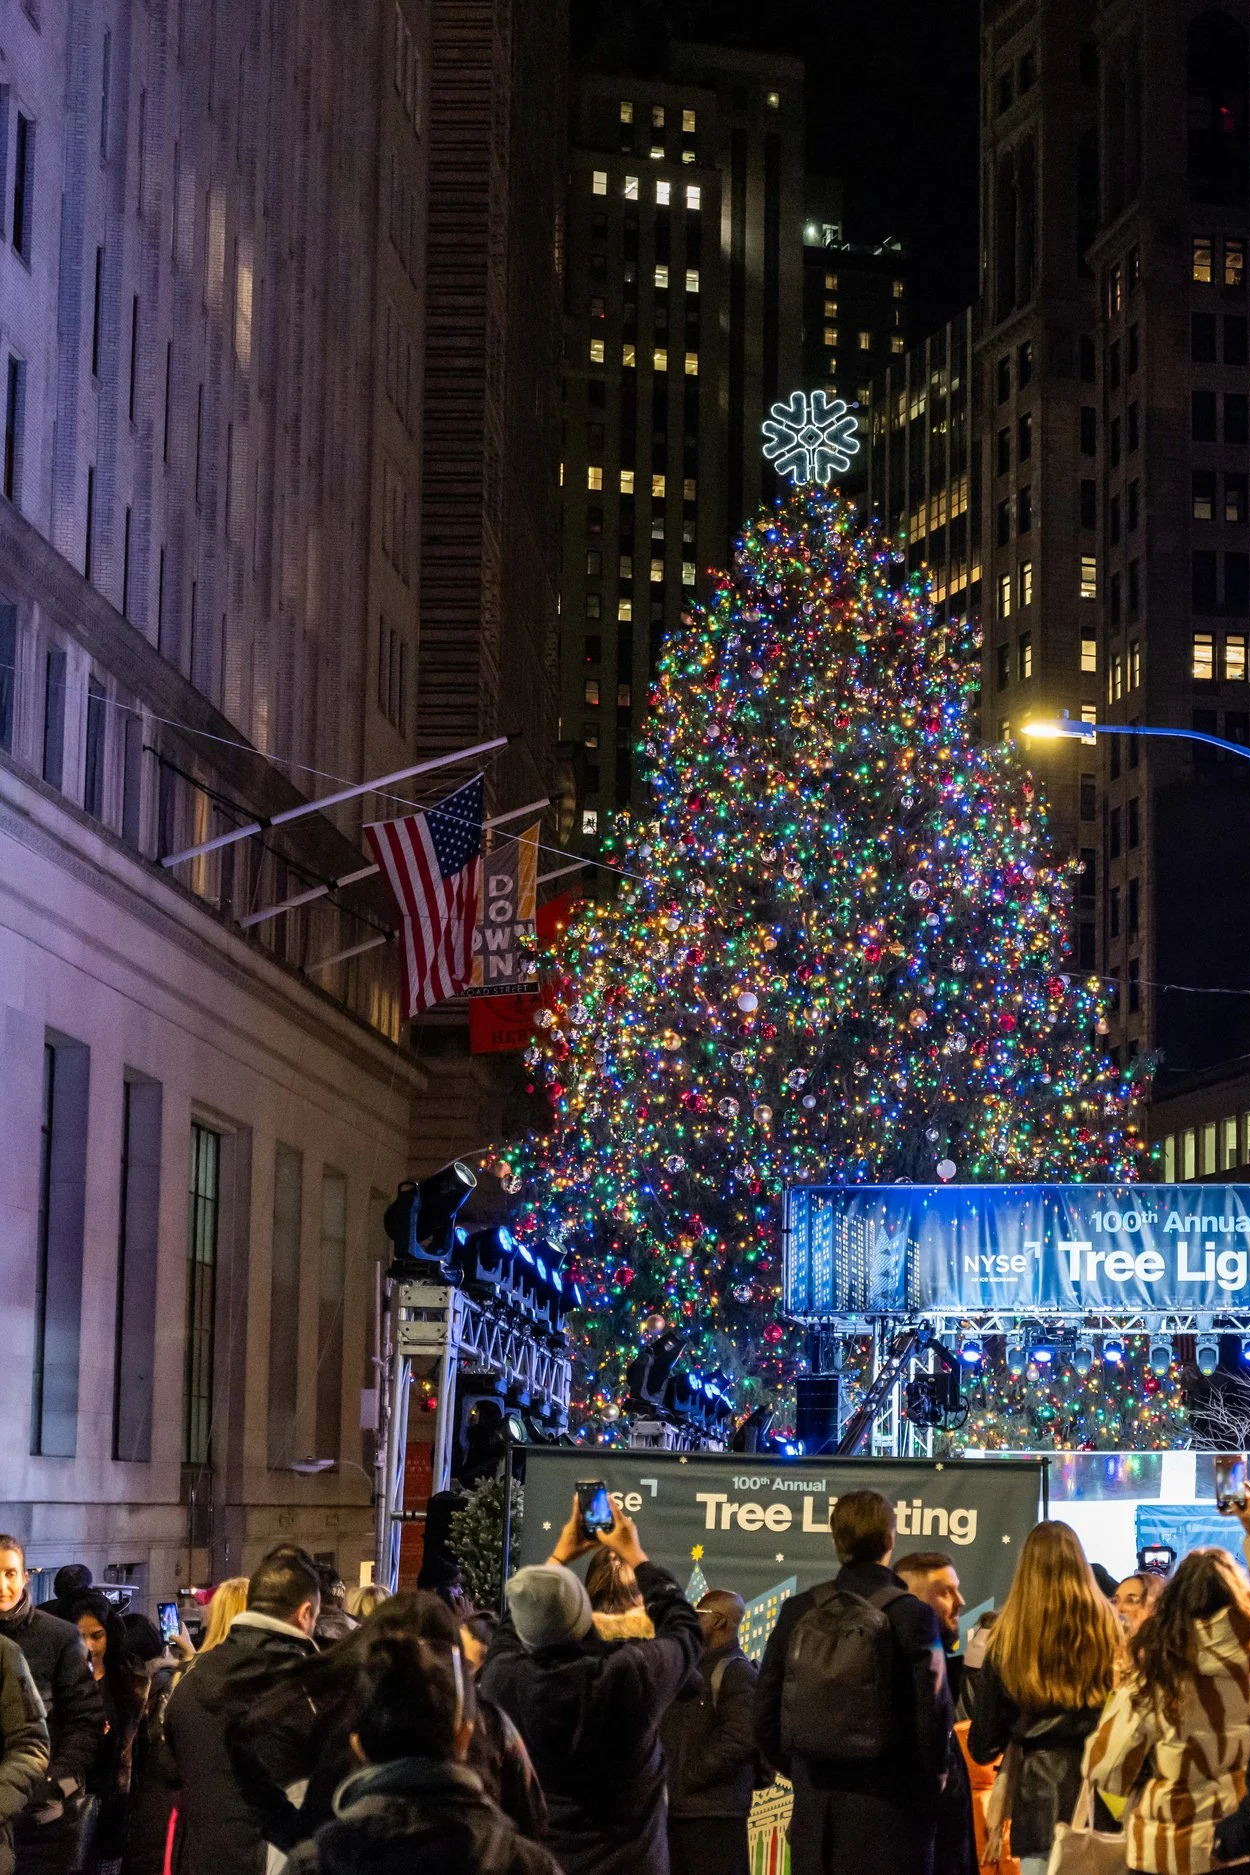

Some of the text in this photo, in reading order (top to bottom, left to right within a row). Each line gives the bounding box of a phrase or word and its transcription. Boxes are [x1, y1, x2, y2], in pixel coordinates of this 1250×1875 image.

[493, 984, 528, 995] STREET
[1092, 1210, 1158, 1233] 100th
[1057, 1241, 1166, 1282] Tree
[732, 1476, 826, 1492] 100th Annual
[696, 1493, 978, 1546] Tree Liting
